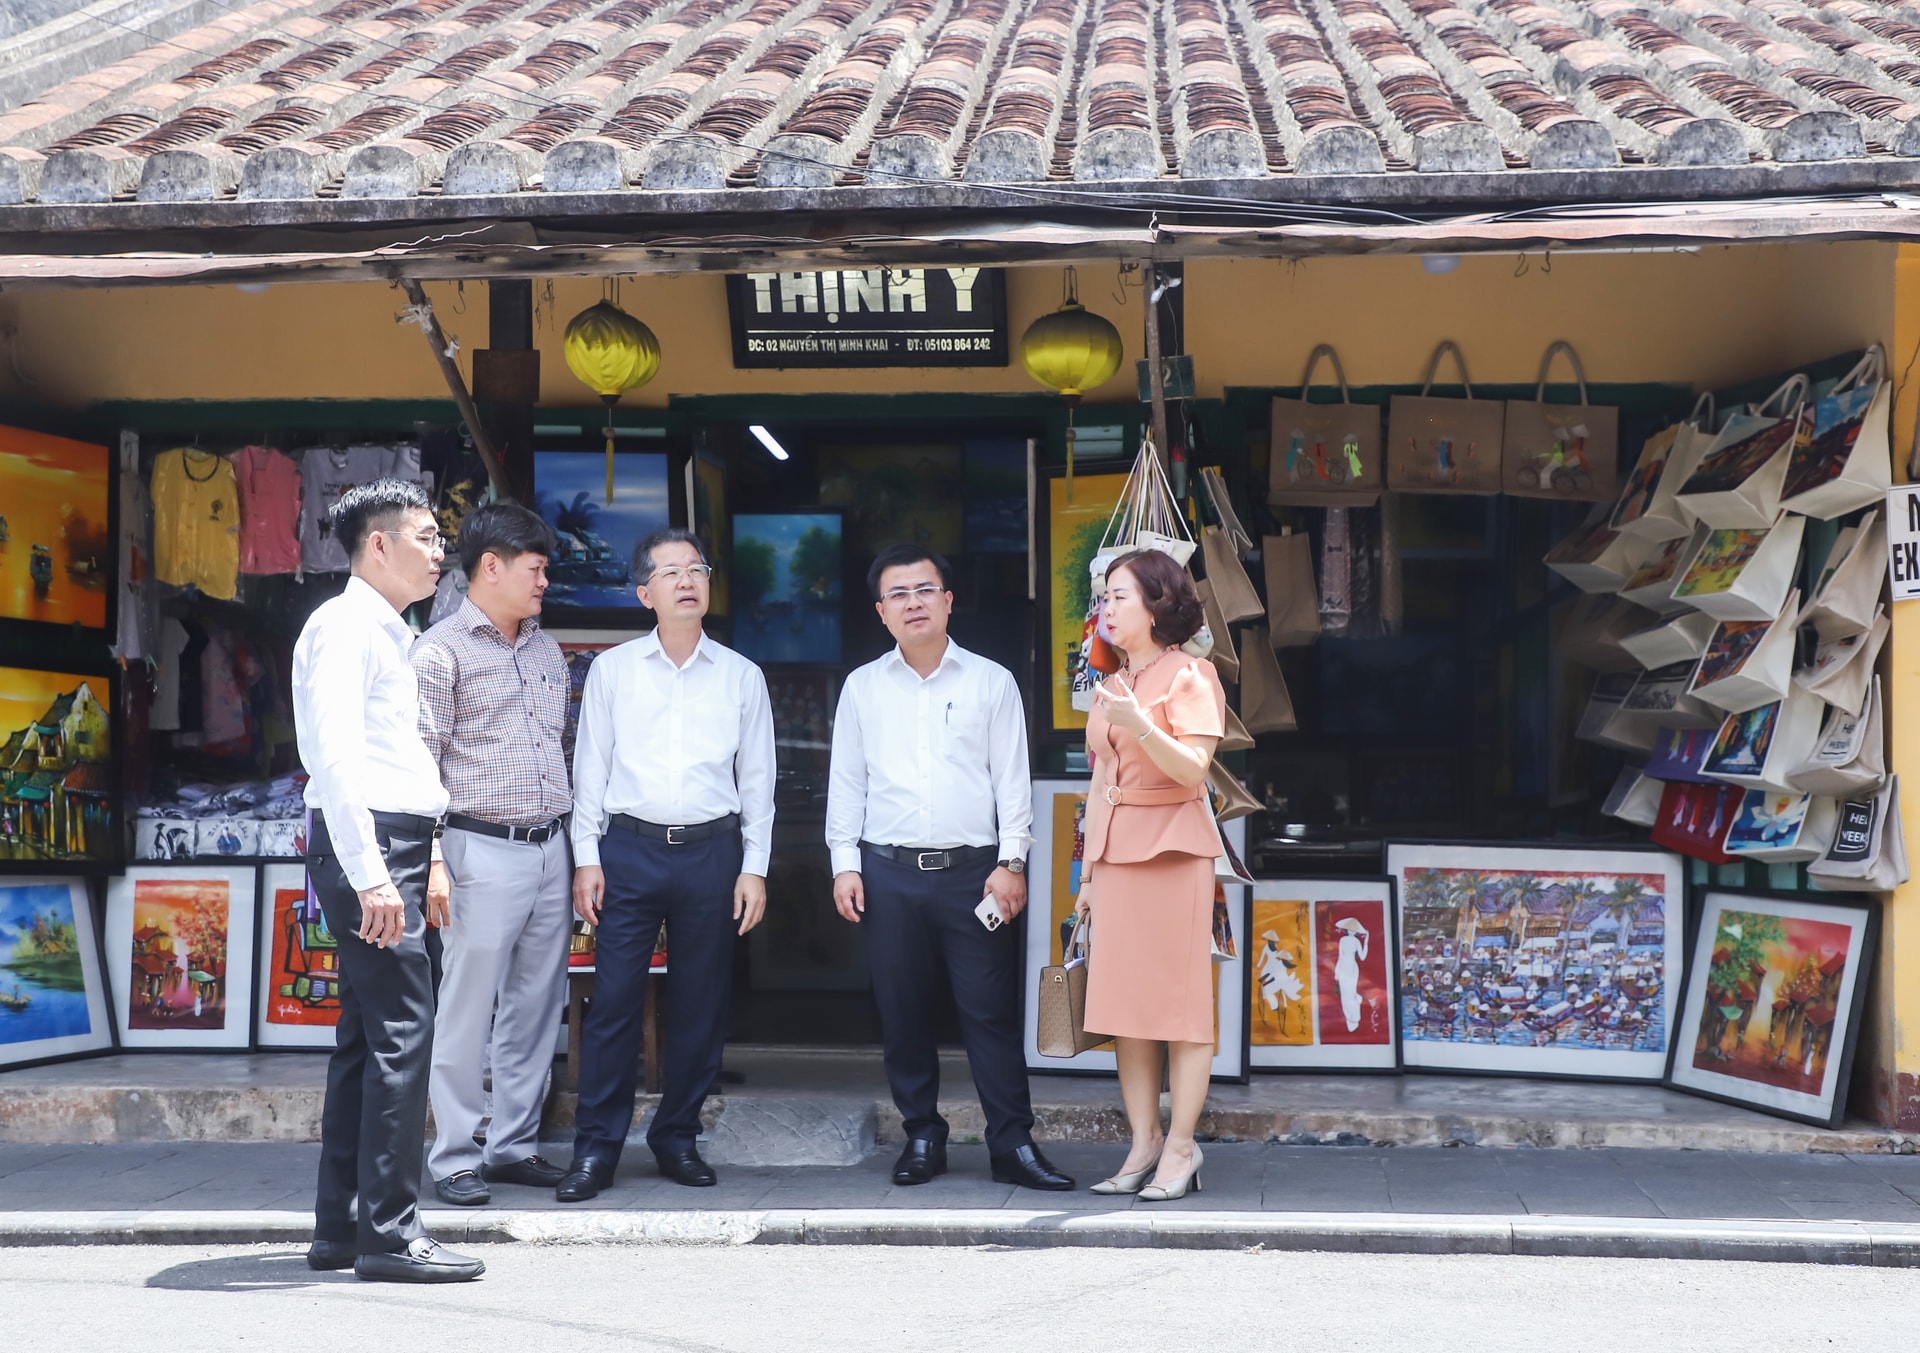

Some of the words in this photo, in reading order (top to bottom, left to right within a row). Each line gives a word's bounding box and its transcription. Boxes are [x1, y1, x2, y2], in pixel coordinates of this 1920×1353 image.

[747, 269, 926, 323] THỊNH
[748, 338, 765, 352] ĐC:
[766, 338, 779, 352] 02
[819, 338, 837, 354] THỊ
[838, 338, 863, 352] MINH
[865, 338, 889, 352] KHAI
[907, 338, 923, 351] ĐT:
[924, 338, 953, 351] 05103
[954, 338, 971, 351] 864
[973, 337, 991, 351] 242
[1893, 542, 1920, 581] EX
